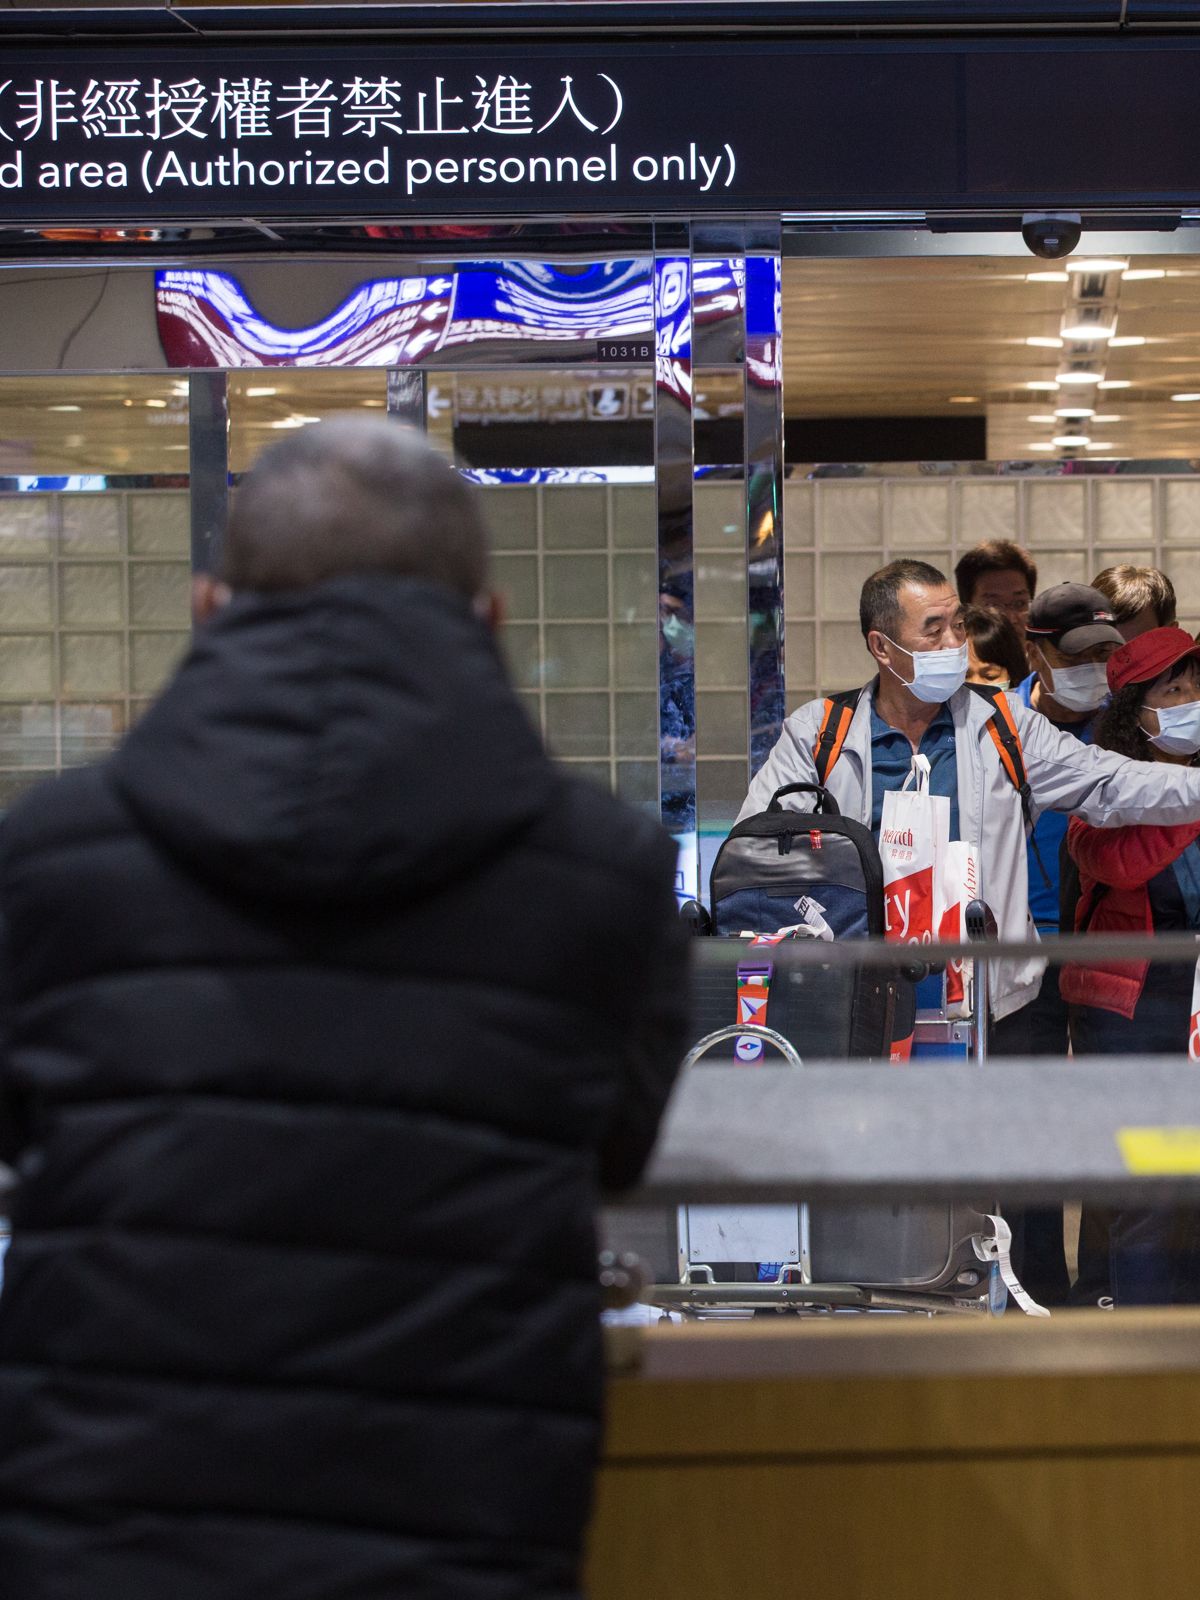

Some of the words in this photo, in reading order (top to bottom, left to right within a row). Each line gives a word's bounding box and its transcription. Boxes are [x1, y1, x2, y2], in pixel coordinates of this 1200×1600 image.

[38, 160, 128, 188] area
[141, 146, 390, 194] (Authorized
[406, 143, 617, 195] personnel
[632, 142, 736, 192] only)
[600, 345, 650, 358] 1031B
